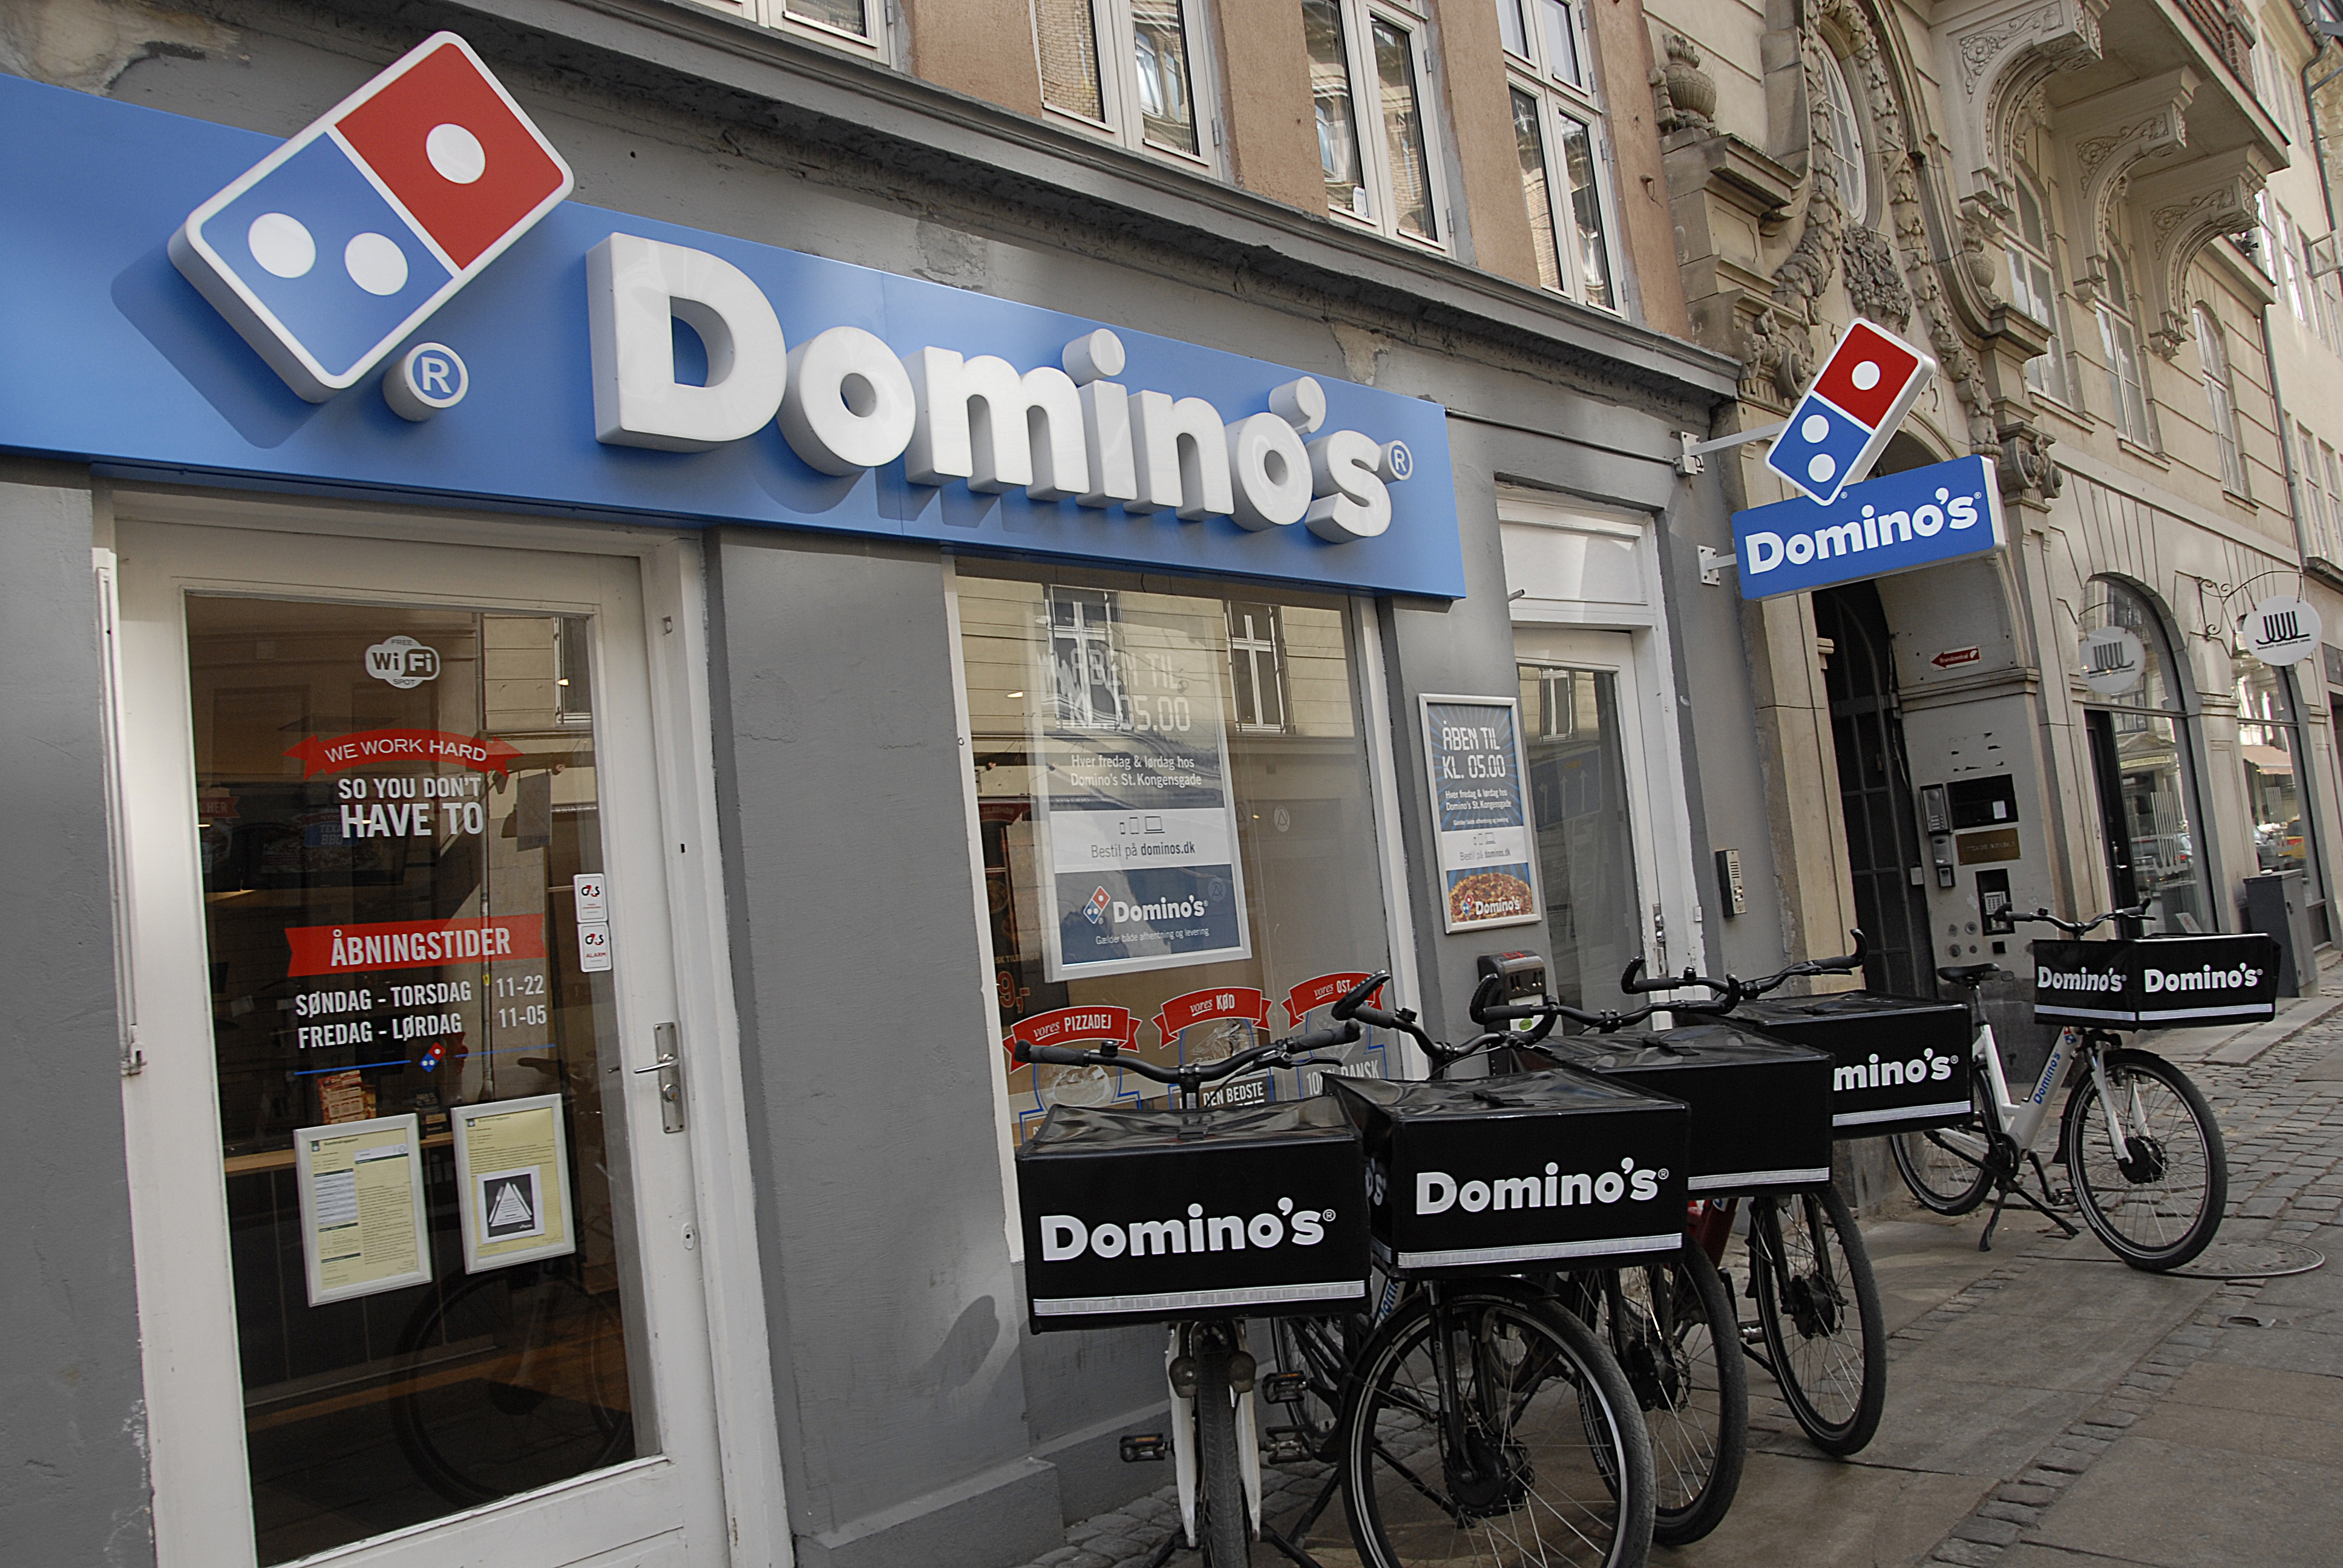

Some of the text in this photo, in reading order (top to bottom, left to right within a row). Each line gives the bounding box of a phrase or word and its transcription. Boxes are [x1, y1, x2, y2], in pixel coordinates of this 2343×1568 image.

[1442, 720, 1501, 750] ÅBEN TIL
[325, 739, 487, 763] WE WORK HARD
[1071, 755, 1194, 770] Hver fredag & lørdag hos
[1442, 754, 1506, 779] KL. 05.00
[338, 777, 482, 799] SO YOU DON'T
[1070, 773, 1202, 788] Domino's St. Kongensgade
[339, 803, 433, 838] HAVE
[442, 802, 483, 835] TO
[1091, 841, 1195, 859] Bestil på dominos.dk
[1475, 896, 1521, 915] Domino's
[330, 928, 512, 967] ÅBNINGSTIDER
[1096, 927, 1210, 944] Gælder både afhentning og levering
[295, 989, 372, 1018] SØNDAG
[390, 981, 472, 1007] TORSDAG
[496, 975, 545, 998] 11-22
[1314, 982, 1334, 998] vores
[1190, 993, 1235, 1013] vores KØD
[298, 1021, 373, 1048] FREDAG
[392, 1013, 462, 1041] LØRDAG
[499, 1005, 548, 1028] 11-05
[1034, 1014, 1112, 1038] vores PIZZADEJ
[1833, 1047, 1959, 1092] mino's®
[1203, 1092, 1224, 1108] DEN
[1226, 1082, 1264, 1102] BEDSTE
